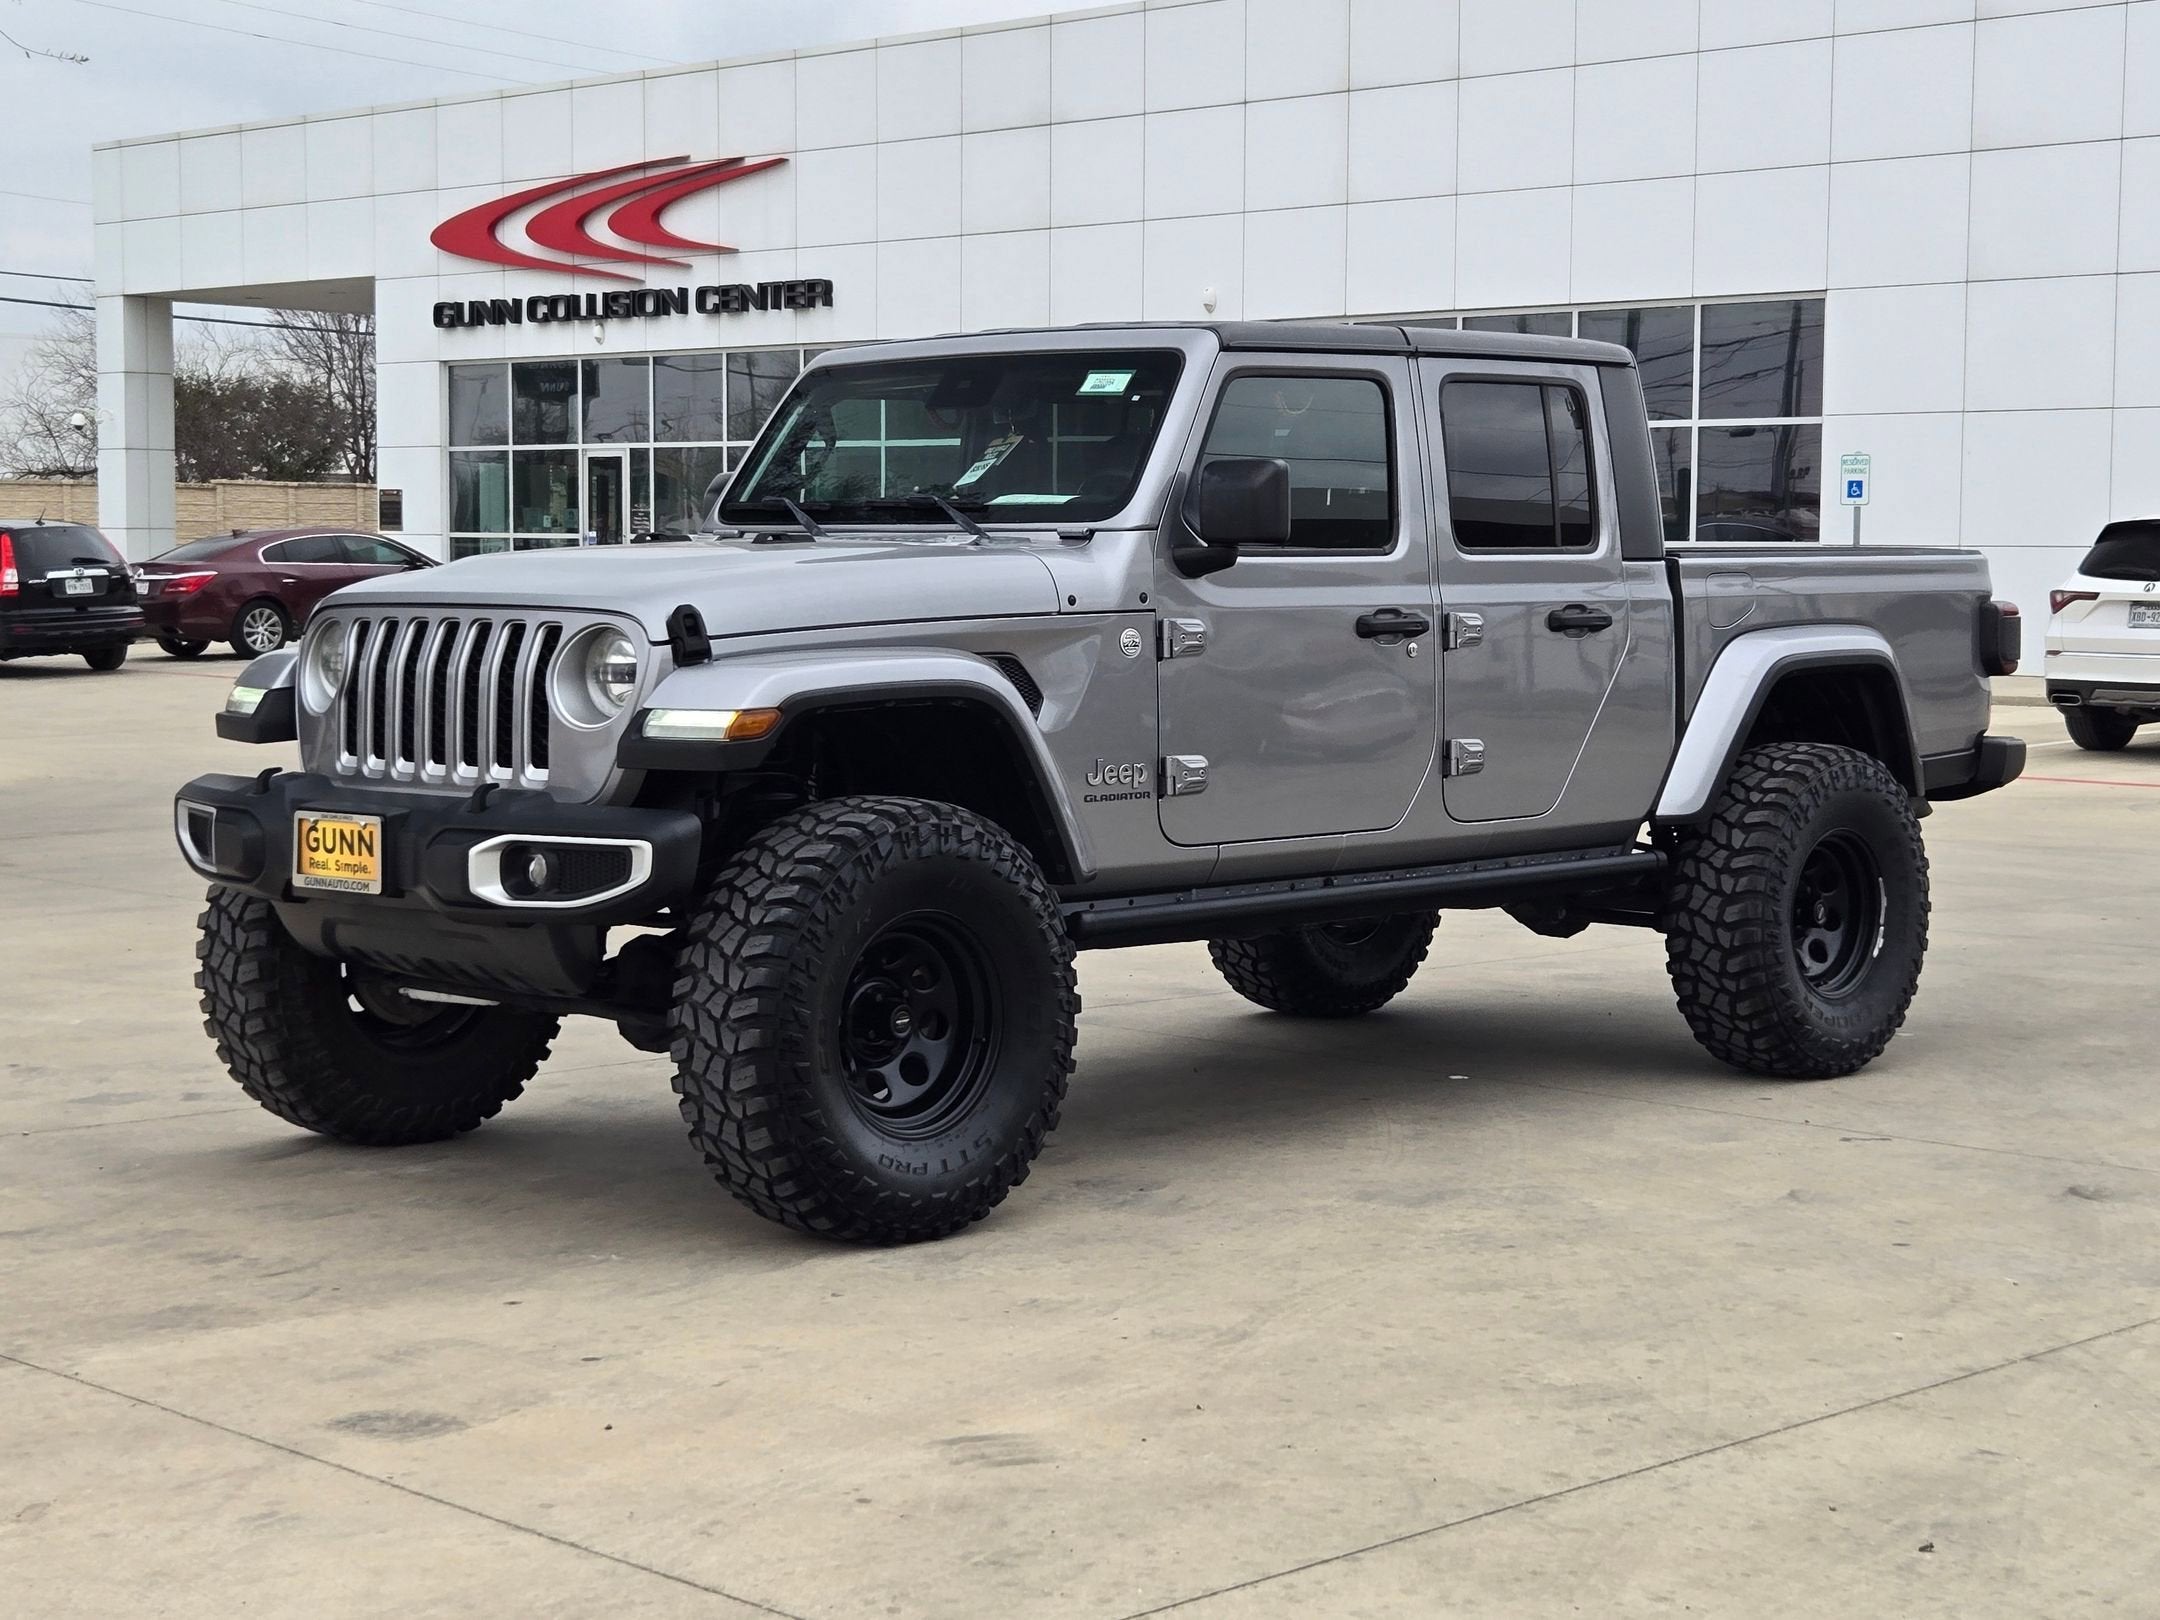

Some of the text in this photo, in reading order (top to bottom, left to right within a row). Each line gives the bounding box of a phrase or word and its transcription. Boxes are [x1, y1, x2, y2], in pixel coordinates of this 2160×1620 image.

[433, 278, 834, 328] GUNN COLLISION CENTER
[1843, 467, 1868, 475] PARKING
[1087, 758, 1149, 789] Jeep
[1083, 791, 1151, 803] GLADIATOR
[305, 824, 375, 857] GUNN
[308, 857, 372, 876] Real. Simple.
[303, 877, 371, 892] GUNNAUTO.COM
[877, 1129, 993, 1177] STT PRO
